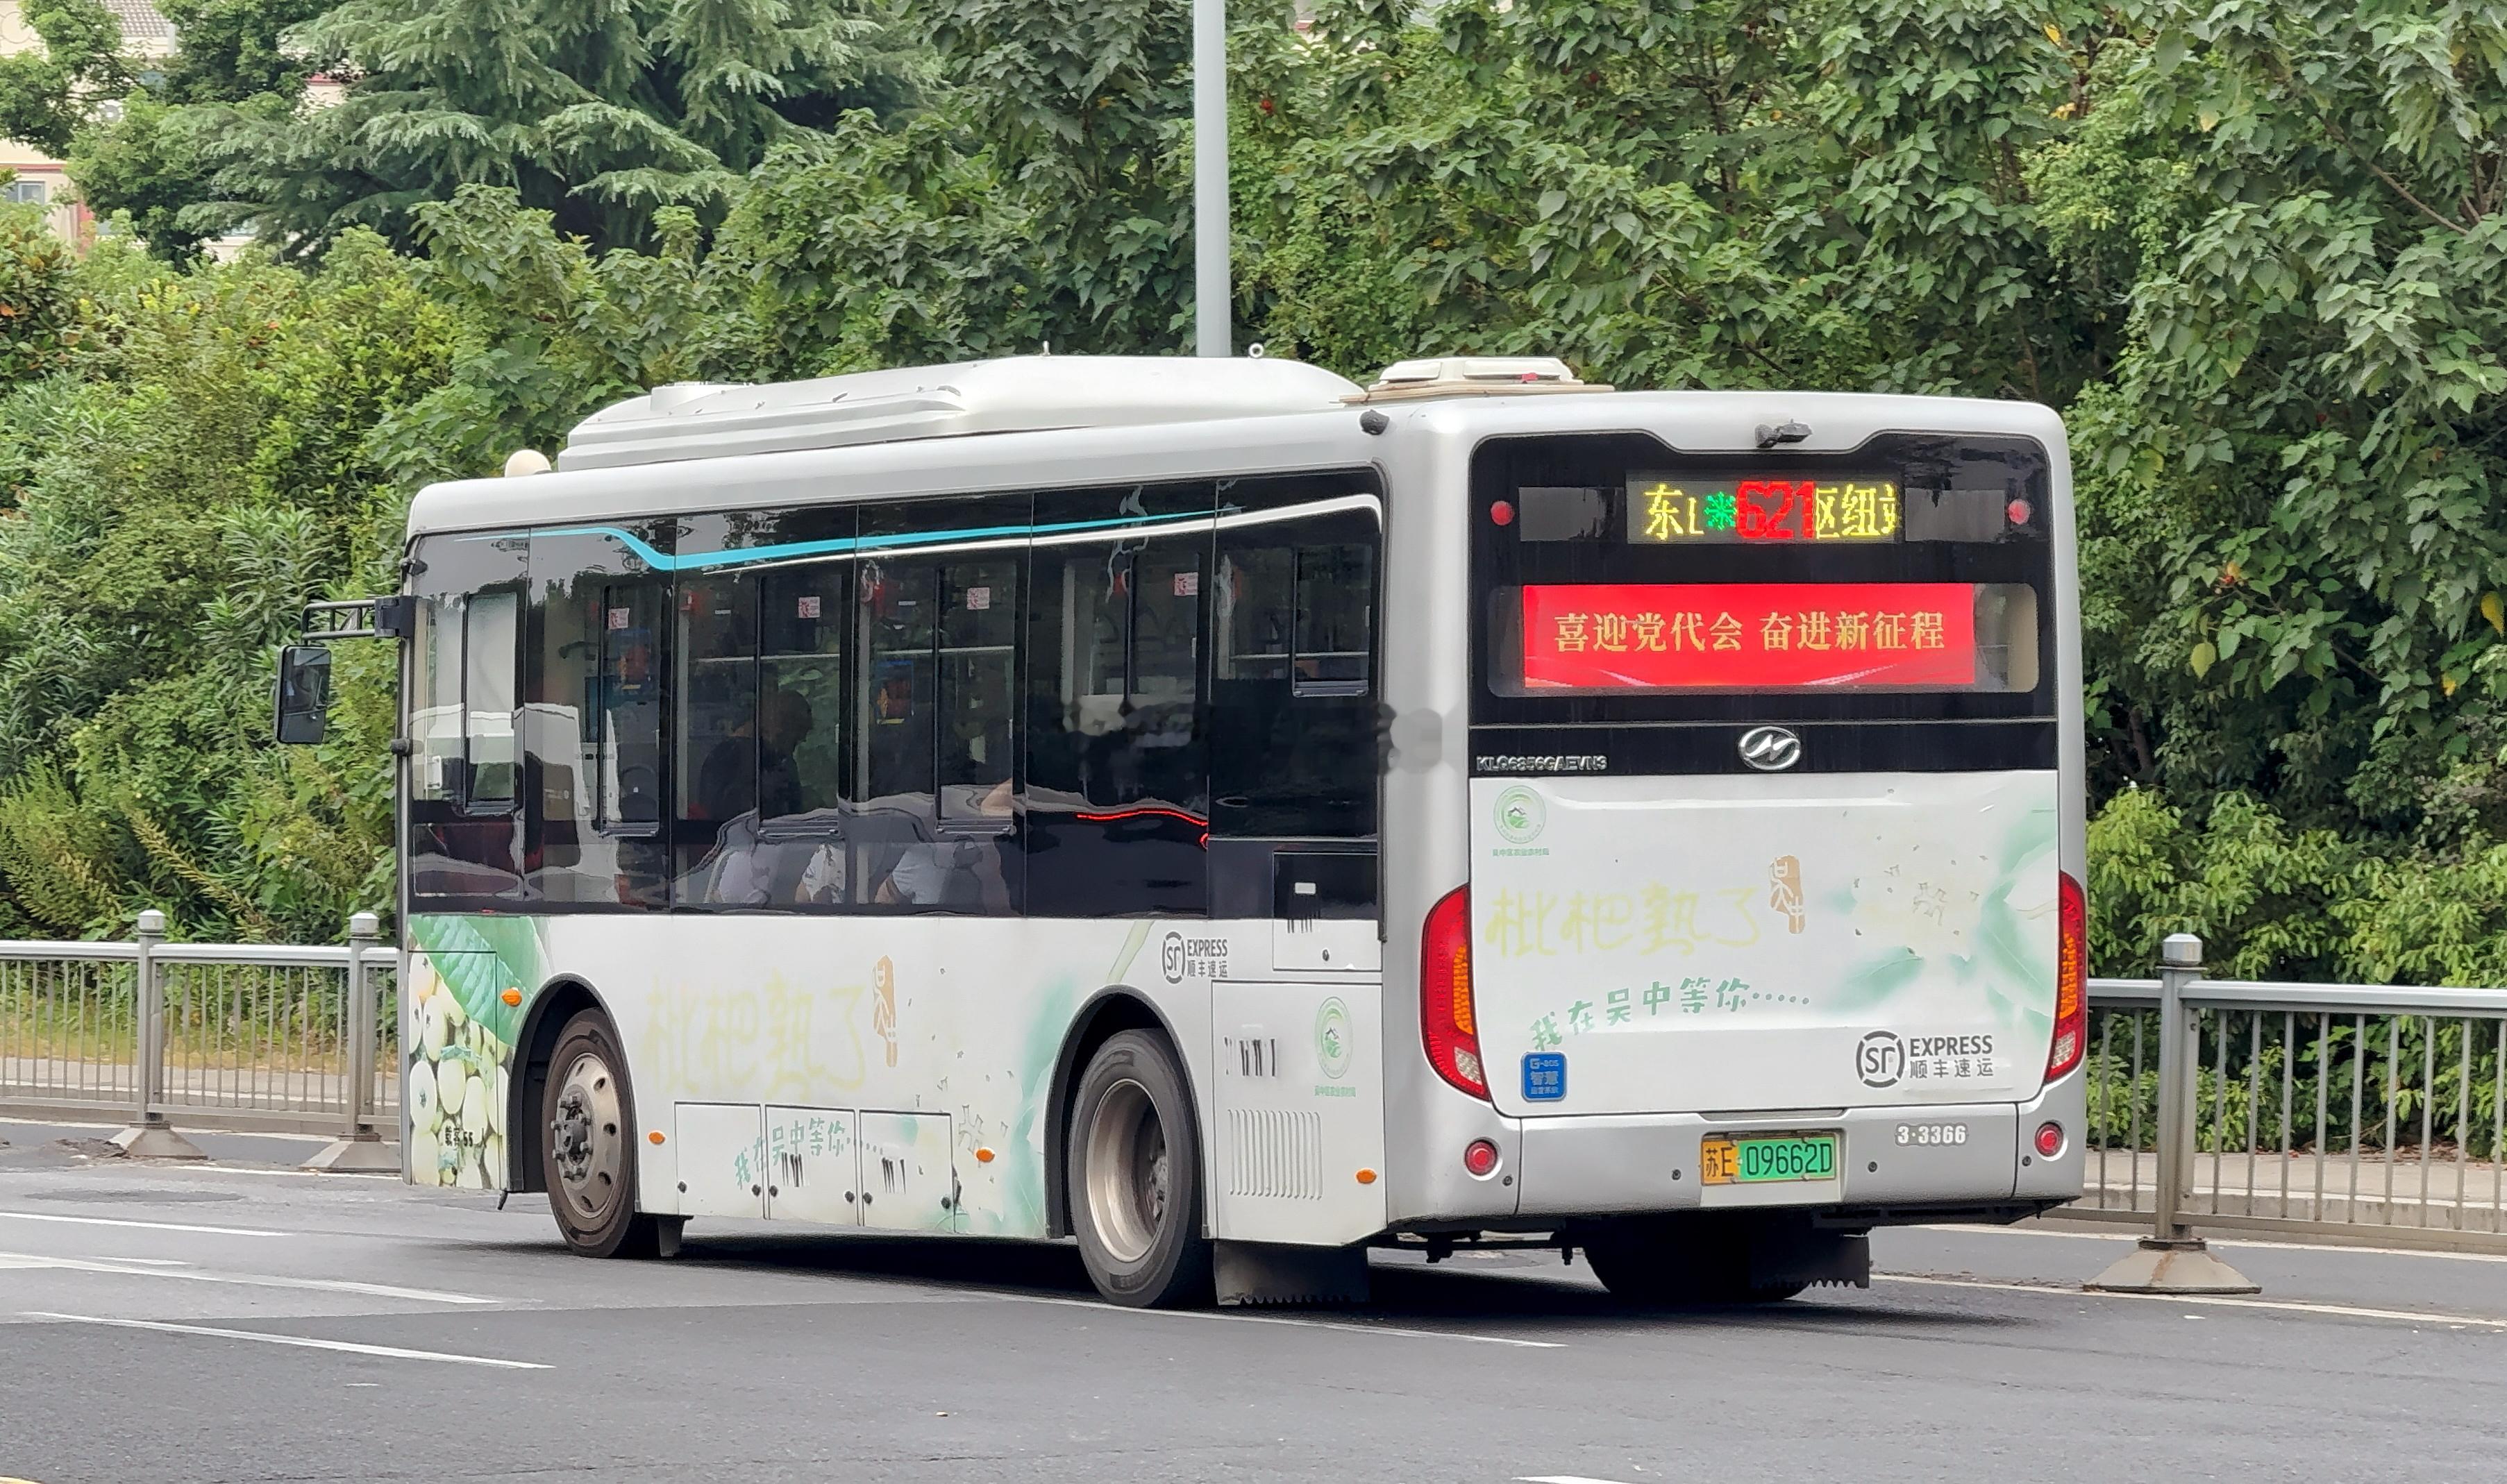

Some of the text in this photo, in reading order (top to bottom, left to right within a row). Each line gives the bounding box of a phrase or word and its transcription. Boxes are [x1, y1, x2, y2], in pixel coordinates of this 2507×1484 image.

[1736, 481, 1815, 539] 621
[1554, 611, 1945, 652] 喜迎党代会 奋进新征程
[1187, 938, 1228, 957] EXPRESS
[1187, 959, 1228, 978] 顺丰速运
[1910, 1035, 1993, 1057] EXPRESS
[1909, 1058, 1994, 1079] 顺丰速运
